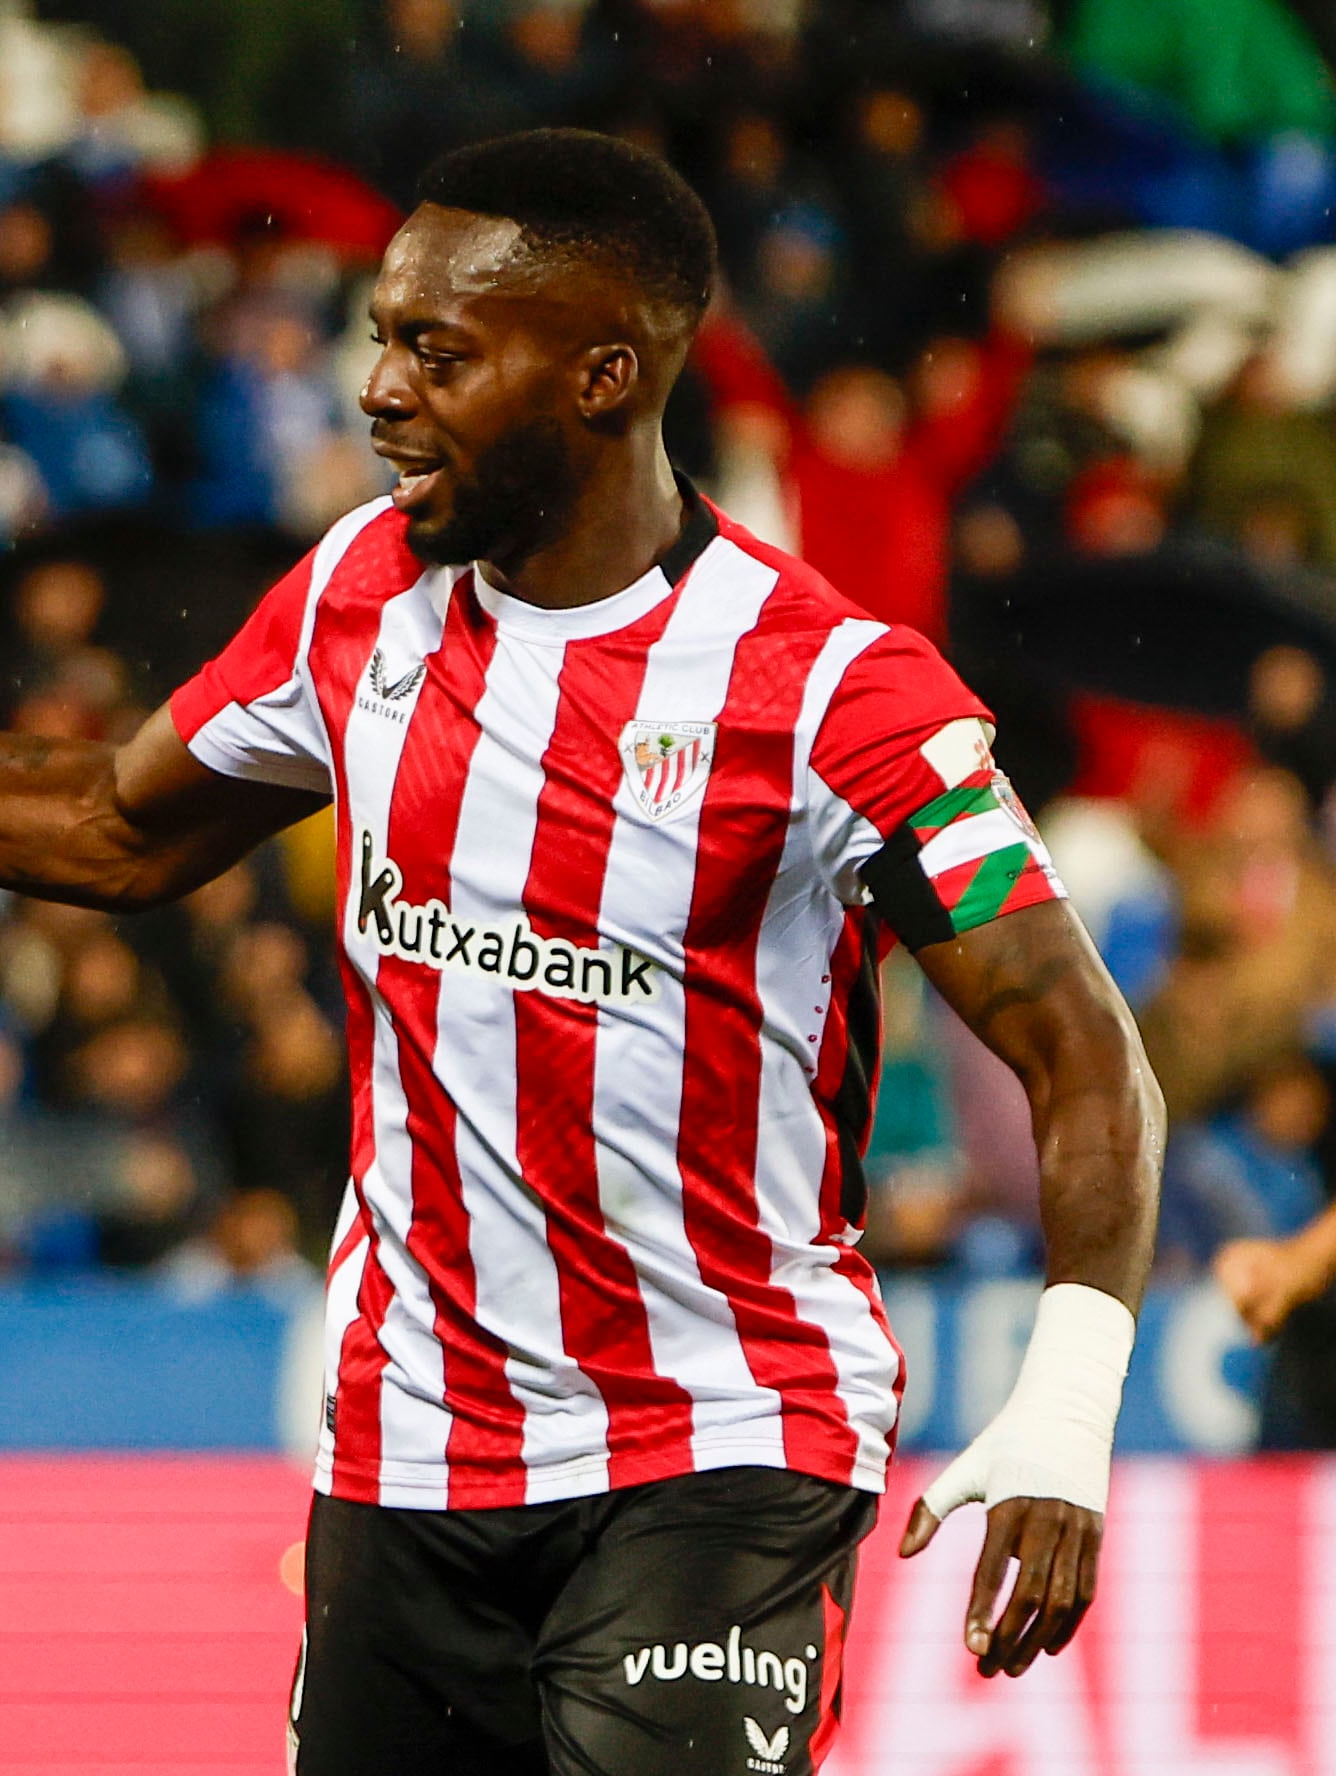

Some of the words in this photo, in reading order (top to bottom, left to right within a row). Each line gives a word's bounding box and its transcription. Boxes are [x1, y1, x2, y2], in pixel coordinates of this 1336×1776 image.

[358, 696, 406, 725] CASTORE
[681, 724, 711, 735] CLUB
[357, 829, 654, 997] Kutxabank
[623, 1625, 808, 1714] vueling
